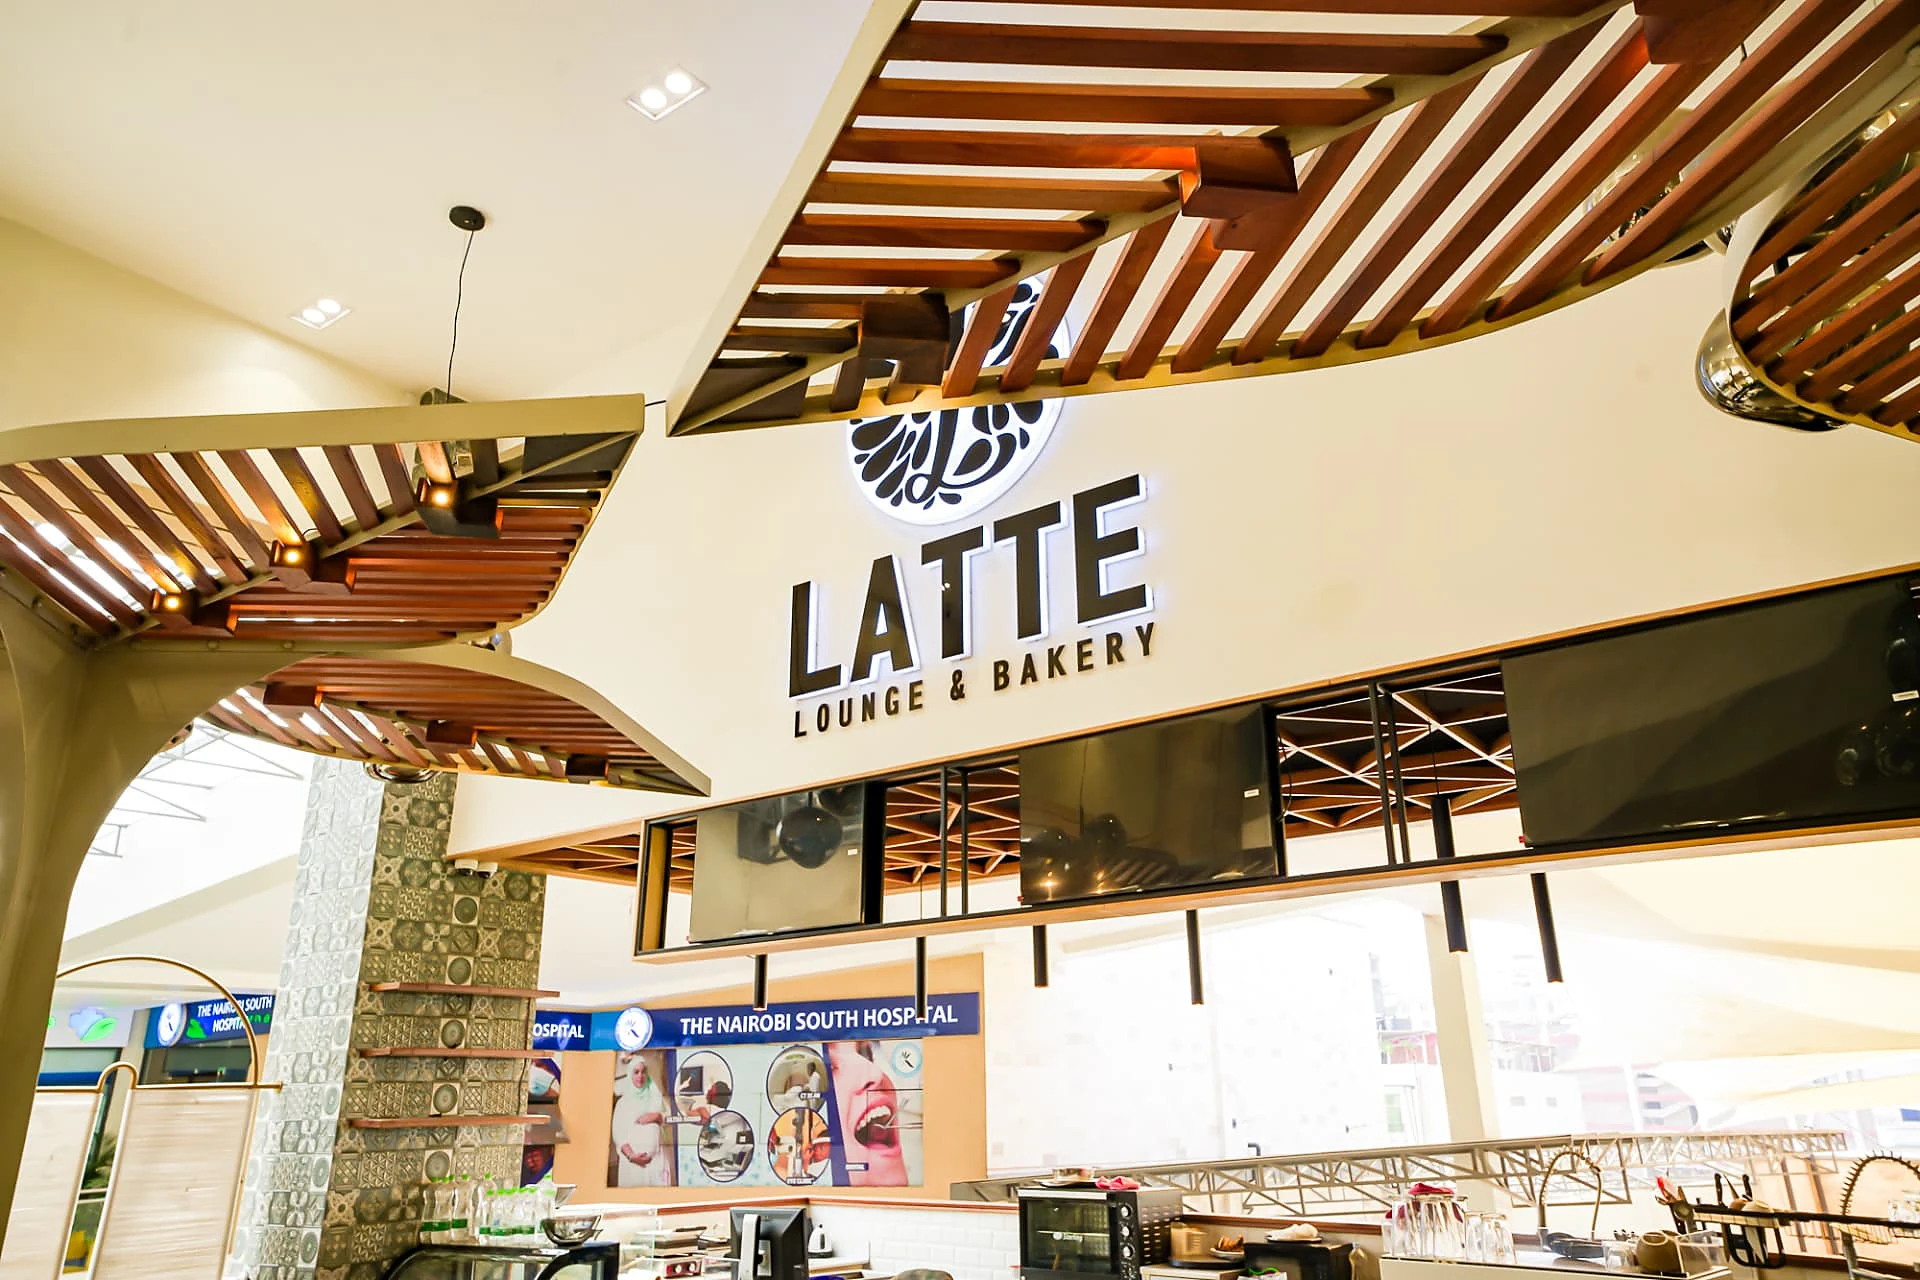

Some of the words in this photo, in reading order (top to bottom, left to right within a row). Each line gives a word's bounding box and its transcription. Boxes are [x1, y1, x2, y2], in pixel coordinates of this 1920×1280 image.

[788, 473, 1155, 698] LATTE
[793, 680, 924, 738] LOUNGE
[949, 668, 966, 701] &
[992, 622, 1155, 691] BAKERY
[198, 1005, 212, 1017] THE
[245, 996, 272, 1011] SOUTH
[213, 1017, 246, 1032] HOSPITA
[533, 1023, 585, 1039] OSPITAL
[680, 1017, 713, 1035] THE
[717, 1013, 791, 1033] NAIROBI
[795, 1009, 858, 1031] SOUTH
